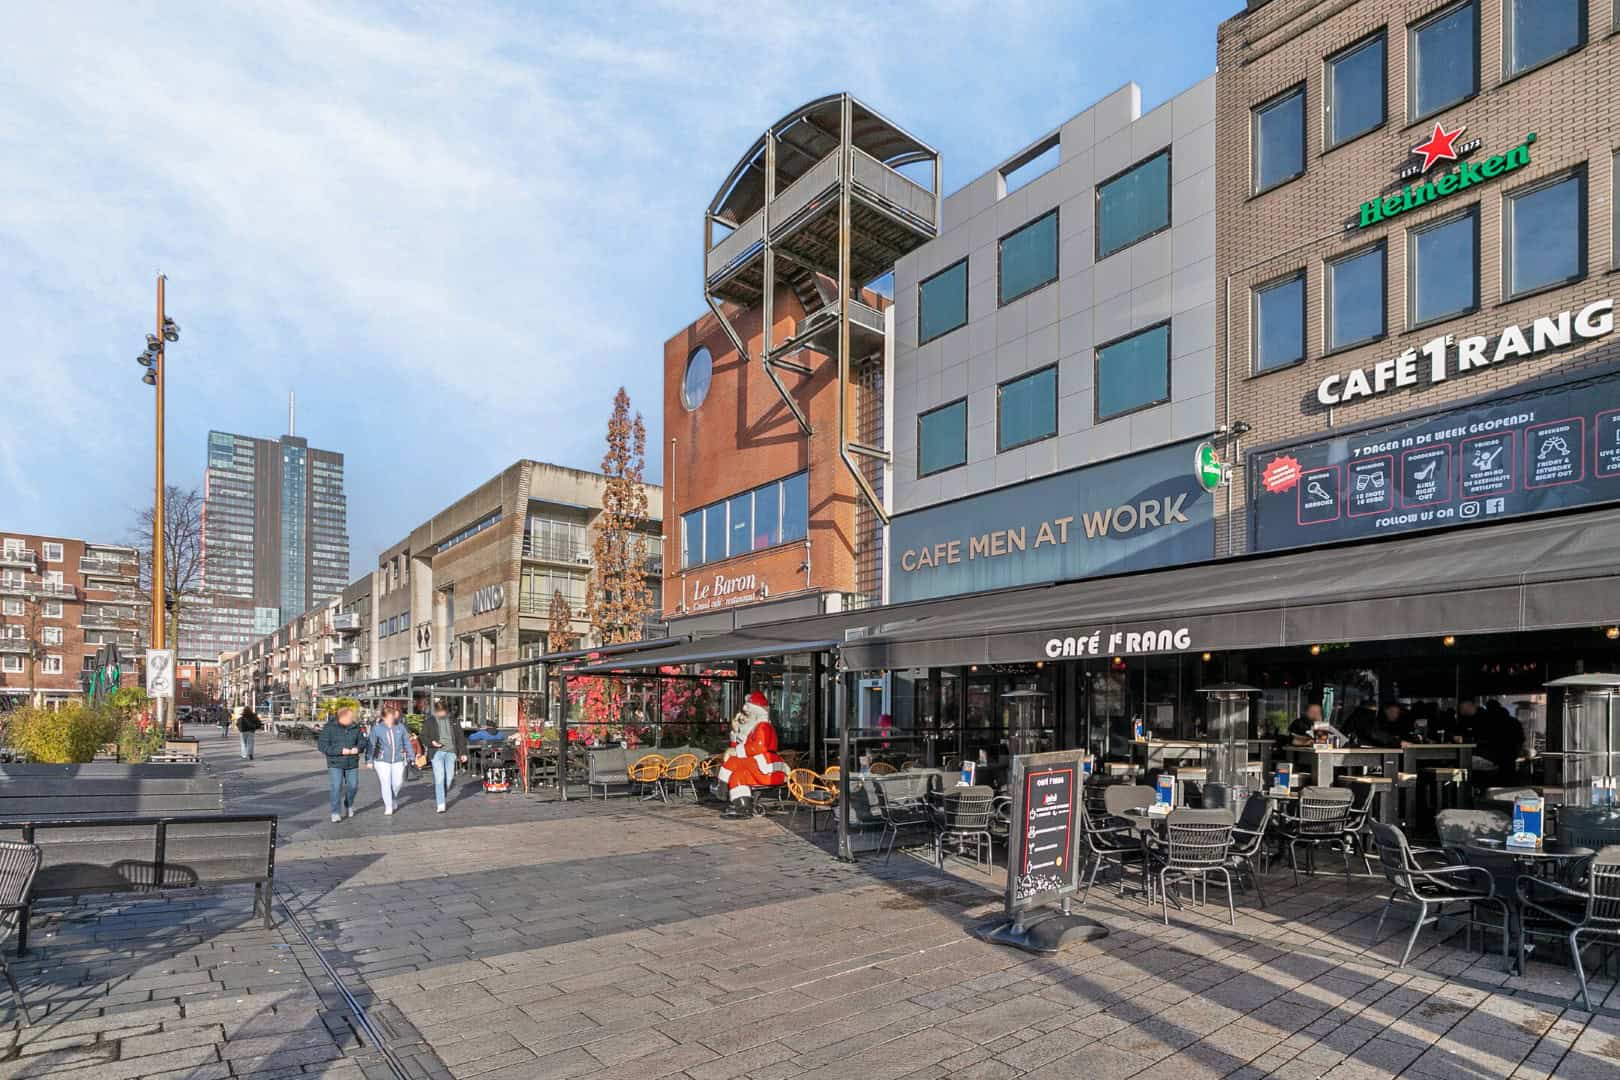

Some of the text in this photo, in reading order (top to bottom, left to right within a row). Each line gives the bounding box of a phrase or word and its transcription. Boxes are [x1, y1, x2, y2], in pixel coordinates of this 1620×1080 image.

[1401, 139, 1481, 178] EST. 1873
[1359, 143, 1531, 229] Heineken
[1317, 347, 1418, 405] CAFÉ
[1458, 299, 1615, 372] RANG
[1353, 412, 1535, 458] 7 DAGEN IN DE WEEK GEOPEND!
[901, 492, 1190, 573] CAFE MEN AT WORK
[1375, 508, 1454, 528] FOLLOW US ON
[694, 574, 756, 601] Le Baron
[1045, 630, 1102, 659] CAFÉ
[1126, 628, 1192, 654] RANG
